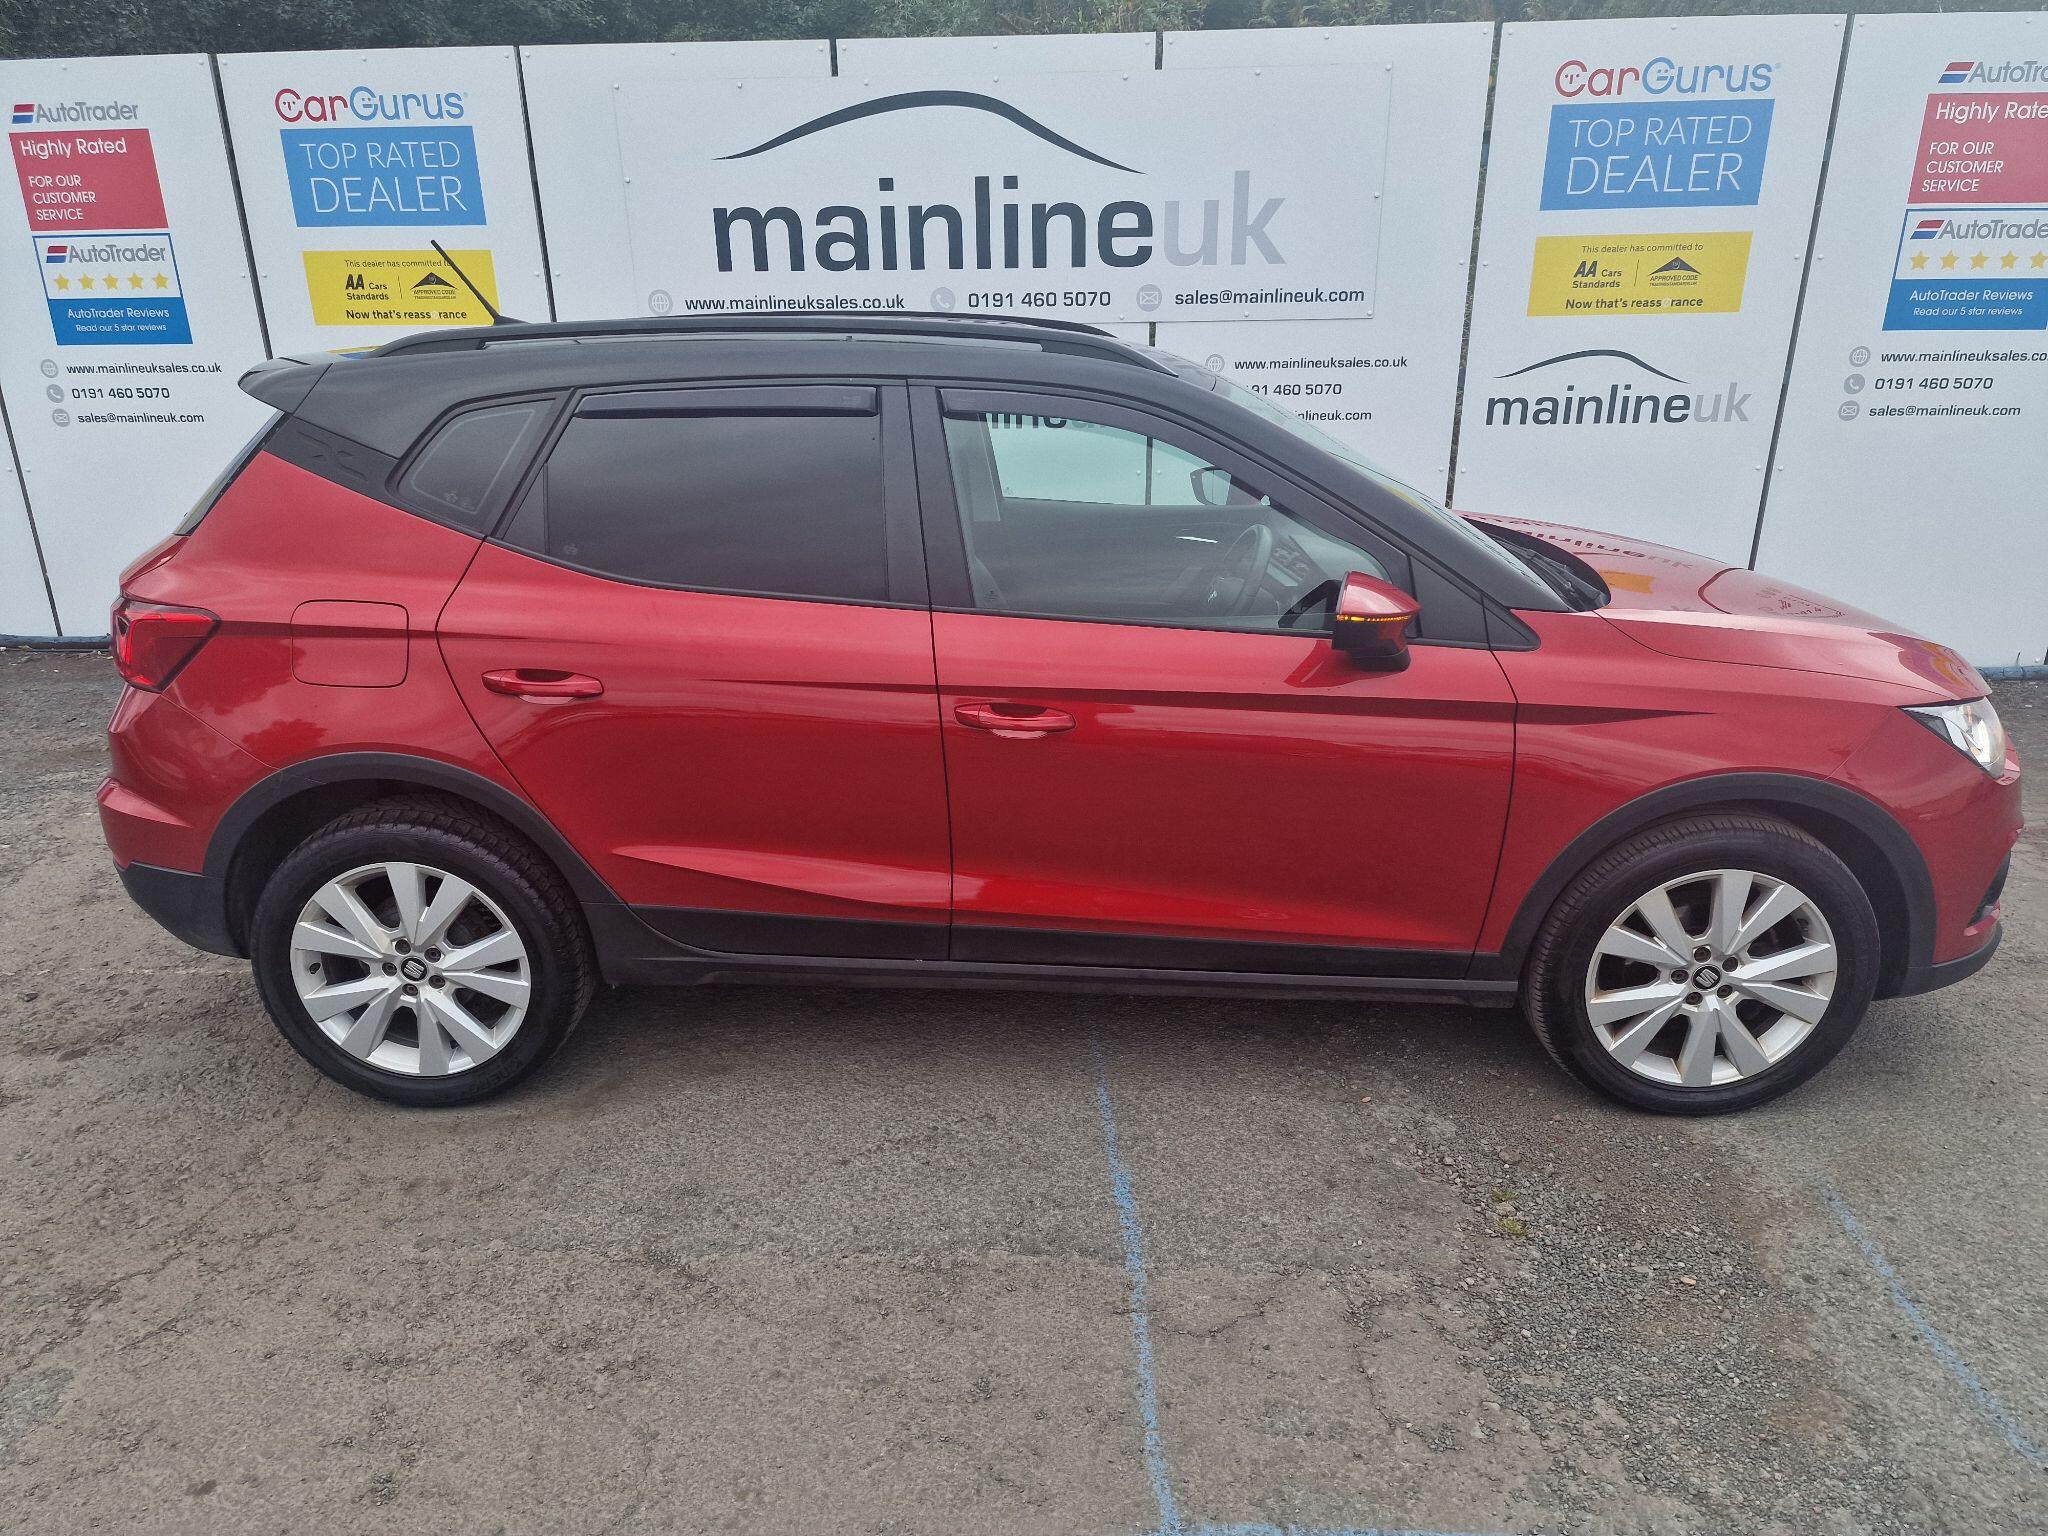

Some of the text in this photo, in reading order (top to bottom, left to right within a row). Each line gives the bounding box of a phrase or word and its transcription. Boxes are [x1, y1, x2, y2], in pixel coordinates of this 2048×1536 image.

[1555, 56, 1773, 97] CarGurus
[274, 86, 465, 122] CarGurus
[36, 101, 139, 123] AutoTrader
[1936, 102, 2000, 124] Highly
[1568, 115, 1752, 148] TOP RATED
[20, 137, 128, 160] Highly Rated
[1929, 142, 1995, 154] FOR OUR
[299, 141, 461, 169] TOP RATED
[1567, 152, 1743, 195] DEALER
[1926, 160, 2004, 174] CUSTOMER
[28, 174, 82, 188] FOR OUR
[1922, 179, 1980, 192] SERVICE
[32, 192, 97, 205] CUSTOMER
[310, 176, 468, 213] DEALER
[36, 208, 84, 221] SERVICE
[712, 170, 1287, 272] mainlineuk
[68, 244, 166, 263] AutoTrader
[1581, 243, 1704, 254] This dealer has committed to
[344, 260, 361, 268] This
[362, 259, 385, 268] dealer
[386, 259, 400, 267] has
[401, 259, 442, 267] committed
[1573, 260, 1622, 278] AA Cars
[345, 274, 388, 290] AA Cars
[1572, 280, 1621, 289] Standards
[346, 292, 390, 300] Standards
[968, 291, 1112, 308] 0191 460 5070
[1174, 288, 1365, 306] sales@mainlineuk.com
[1910, 289, 2034, 301] AutoTrader Reviews
[684, 294, 906, 310] www.mainlineuksales.co.uk
[1565, 298, 1594, 309] Now
[1595, 298, 1628, 309] that's
[67, 307, 170, 319] AutoTrader Reviews
[346, 310, 371, 319] Now
[372, 310, 401, 319] that's
[1913, 307, 2023, 316] Read our 5 star reviews
[76, 324, 98, 332] Read
[66, 362, 222, 374] www.mainlineuksales.co.uk
[1234, 356, 1408, 370] www.mainlineuksales.co.uk
[1273, 384, 1301, 395] 460
[1305, 384, 1342, 395] 5070
[1874, 378, 1994, 390] 0191 460 5070
[72, 388, 170, 399] 0191 460 5070
[1485, 382, 1752, 426] mainlineuk
[77, 412, 205, 423] sales@mainlineuk.com
[1869, 405, 2021, 417] sales@mainlineuk.com
